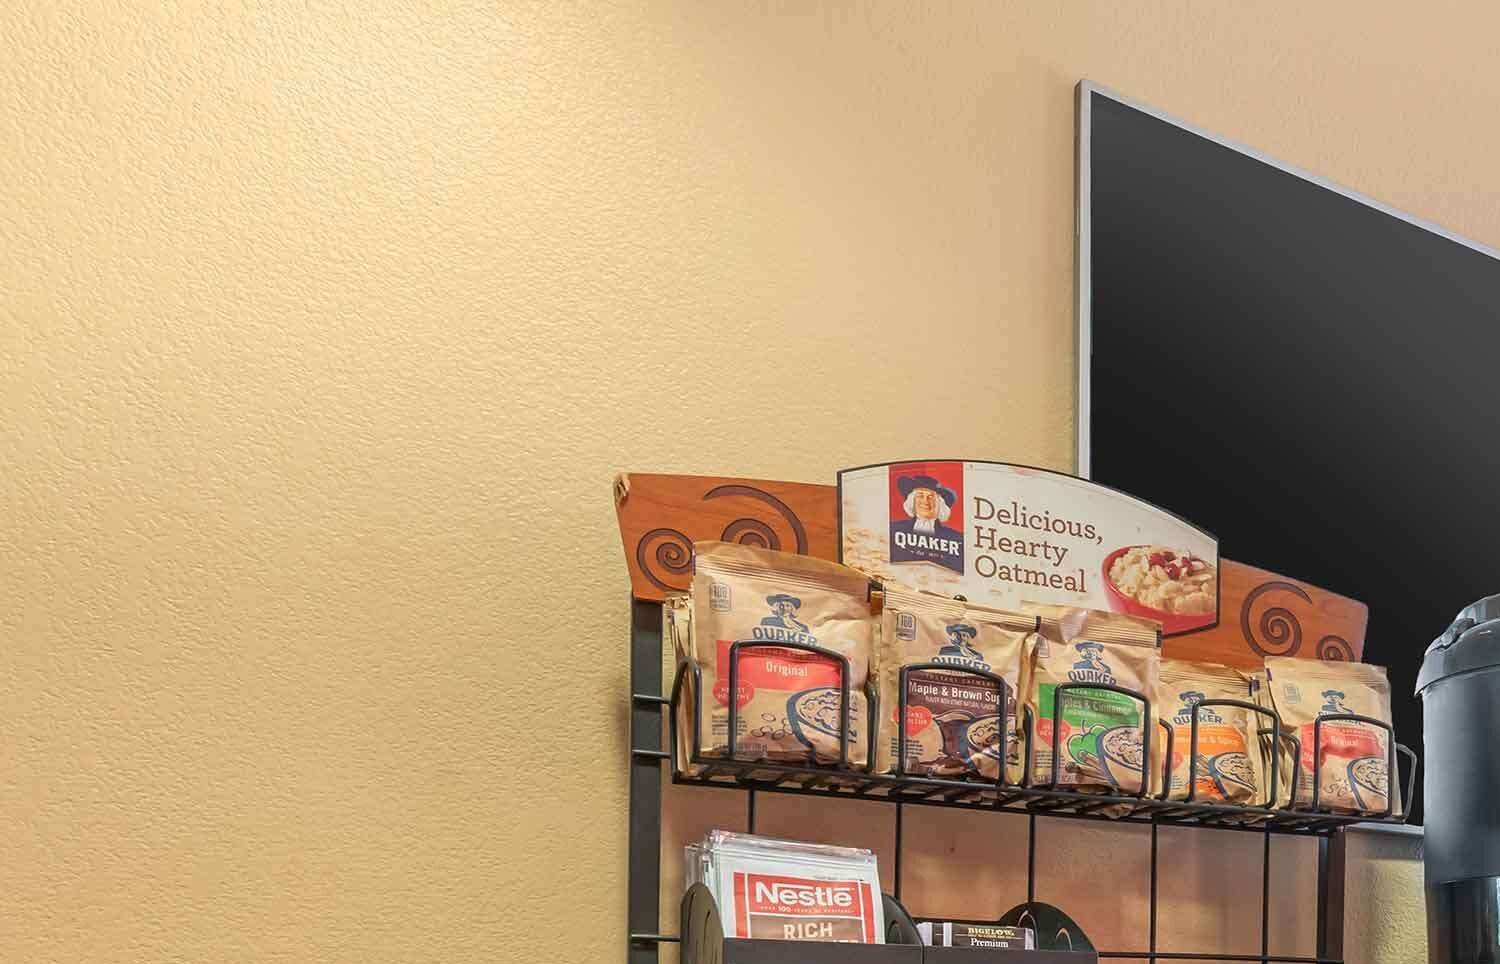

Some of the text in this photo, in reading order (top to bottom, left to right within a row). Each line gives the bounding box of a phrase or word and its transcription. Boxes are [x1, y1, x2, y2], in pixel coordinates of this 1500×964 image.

[973, 496, 1103, 545] Delicious,
[895, 531, 960, 557] QUAKER
[973, 525, 1069, 567] Hearty
[974, 554, 1088, 593] Oatmeal
[752, 626, 817, 647] QUAKER
[765, 661, 808, 677] Original
[1067, 670, 1117, 686] QUAKER
[909, 682, 938, 696] Maple
[941, 686, 950, 696] &
[952, 688, 982, 701] Brown
[985, 692, 1012, 705] Sugr
[1173, 713, 1223, 726] QUKER
[783, 922, 833, 939] RICH
[970, 938, 1009, 948] Premium
